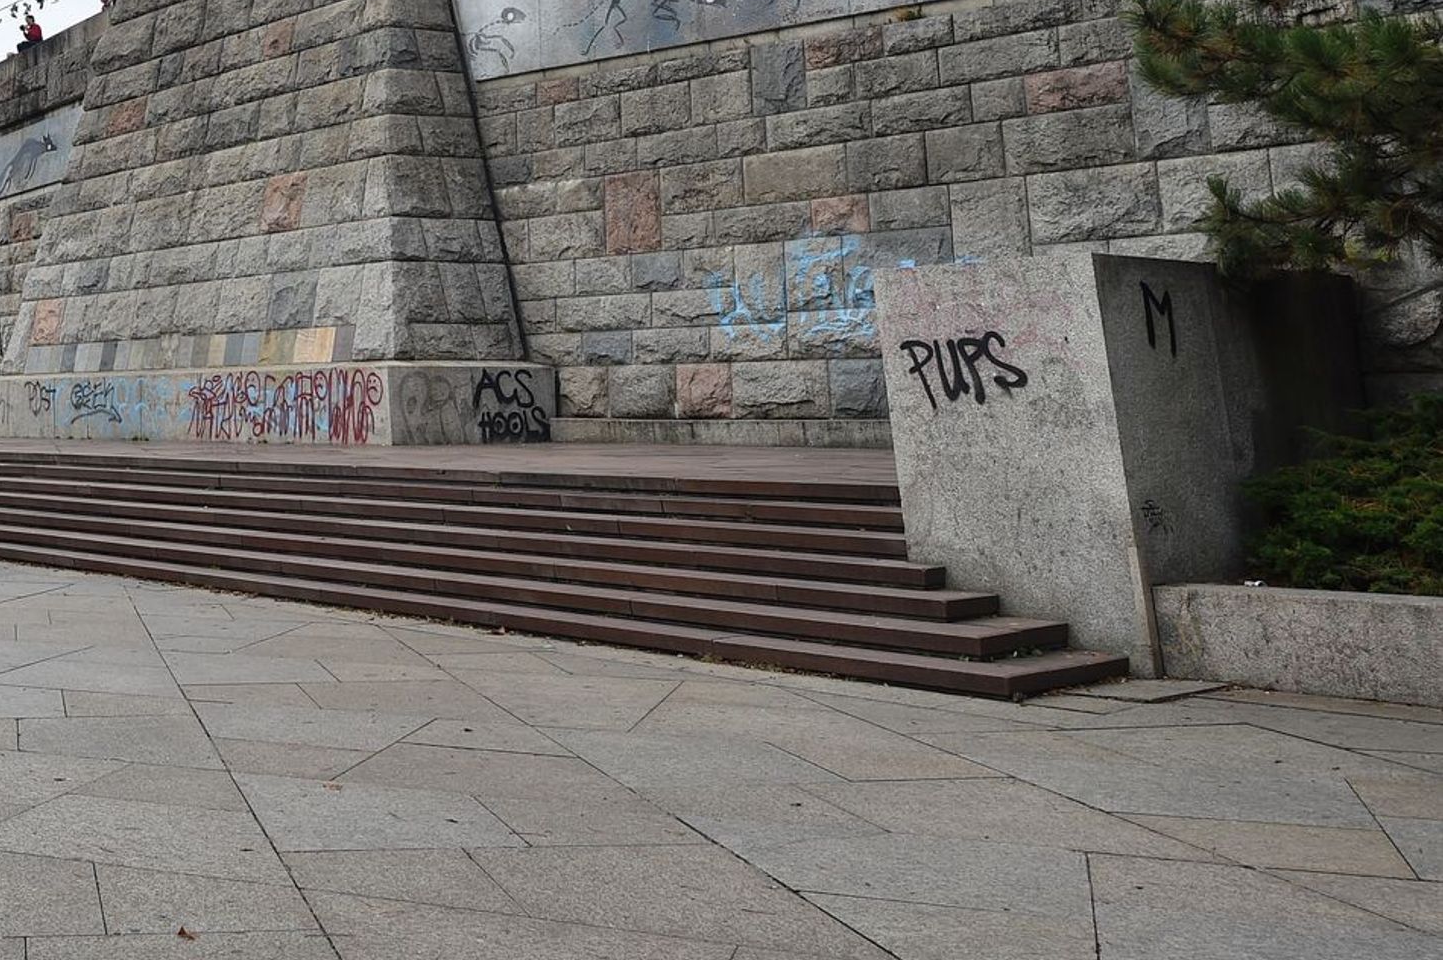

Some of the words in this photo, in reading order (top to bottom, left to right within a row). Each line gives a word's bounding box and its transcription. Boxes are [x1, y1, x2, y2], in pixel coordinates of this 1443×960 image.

[472, 367, 535, 409] ACS
[899, 330, 1028, 410] PUPS
[478, 406, 551, 444] HOOLS
